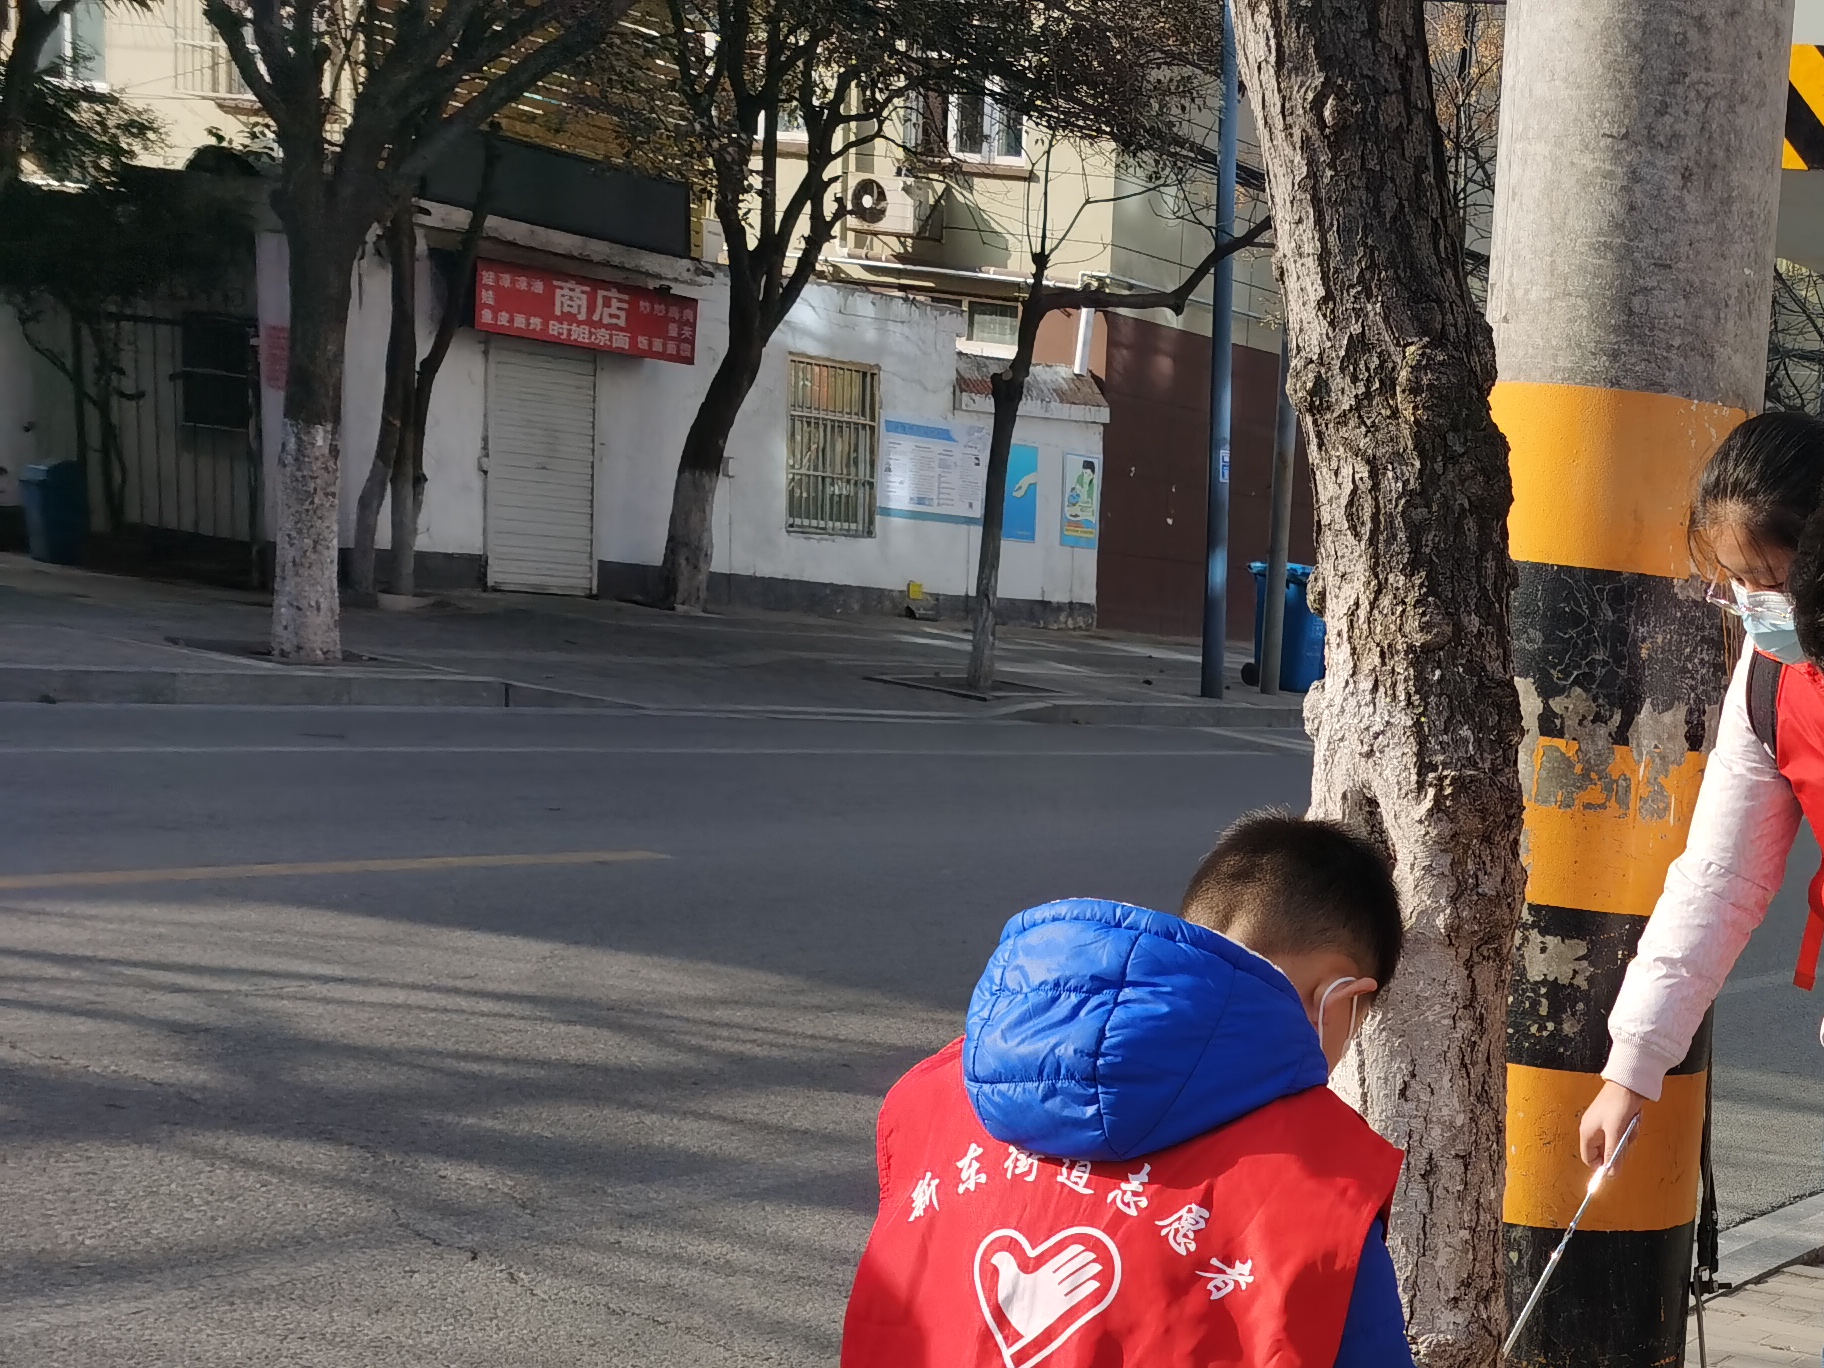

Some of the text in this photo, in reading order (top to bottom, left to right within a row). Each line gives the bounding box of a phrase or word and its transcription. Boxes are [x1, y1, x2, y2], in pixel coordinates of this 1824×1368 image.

[552, 280, 629, 327] 商店
[548, 320, 631, 350] 时姐凉面
